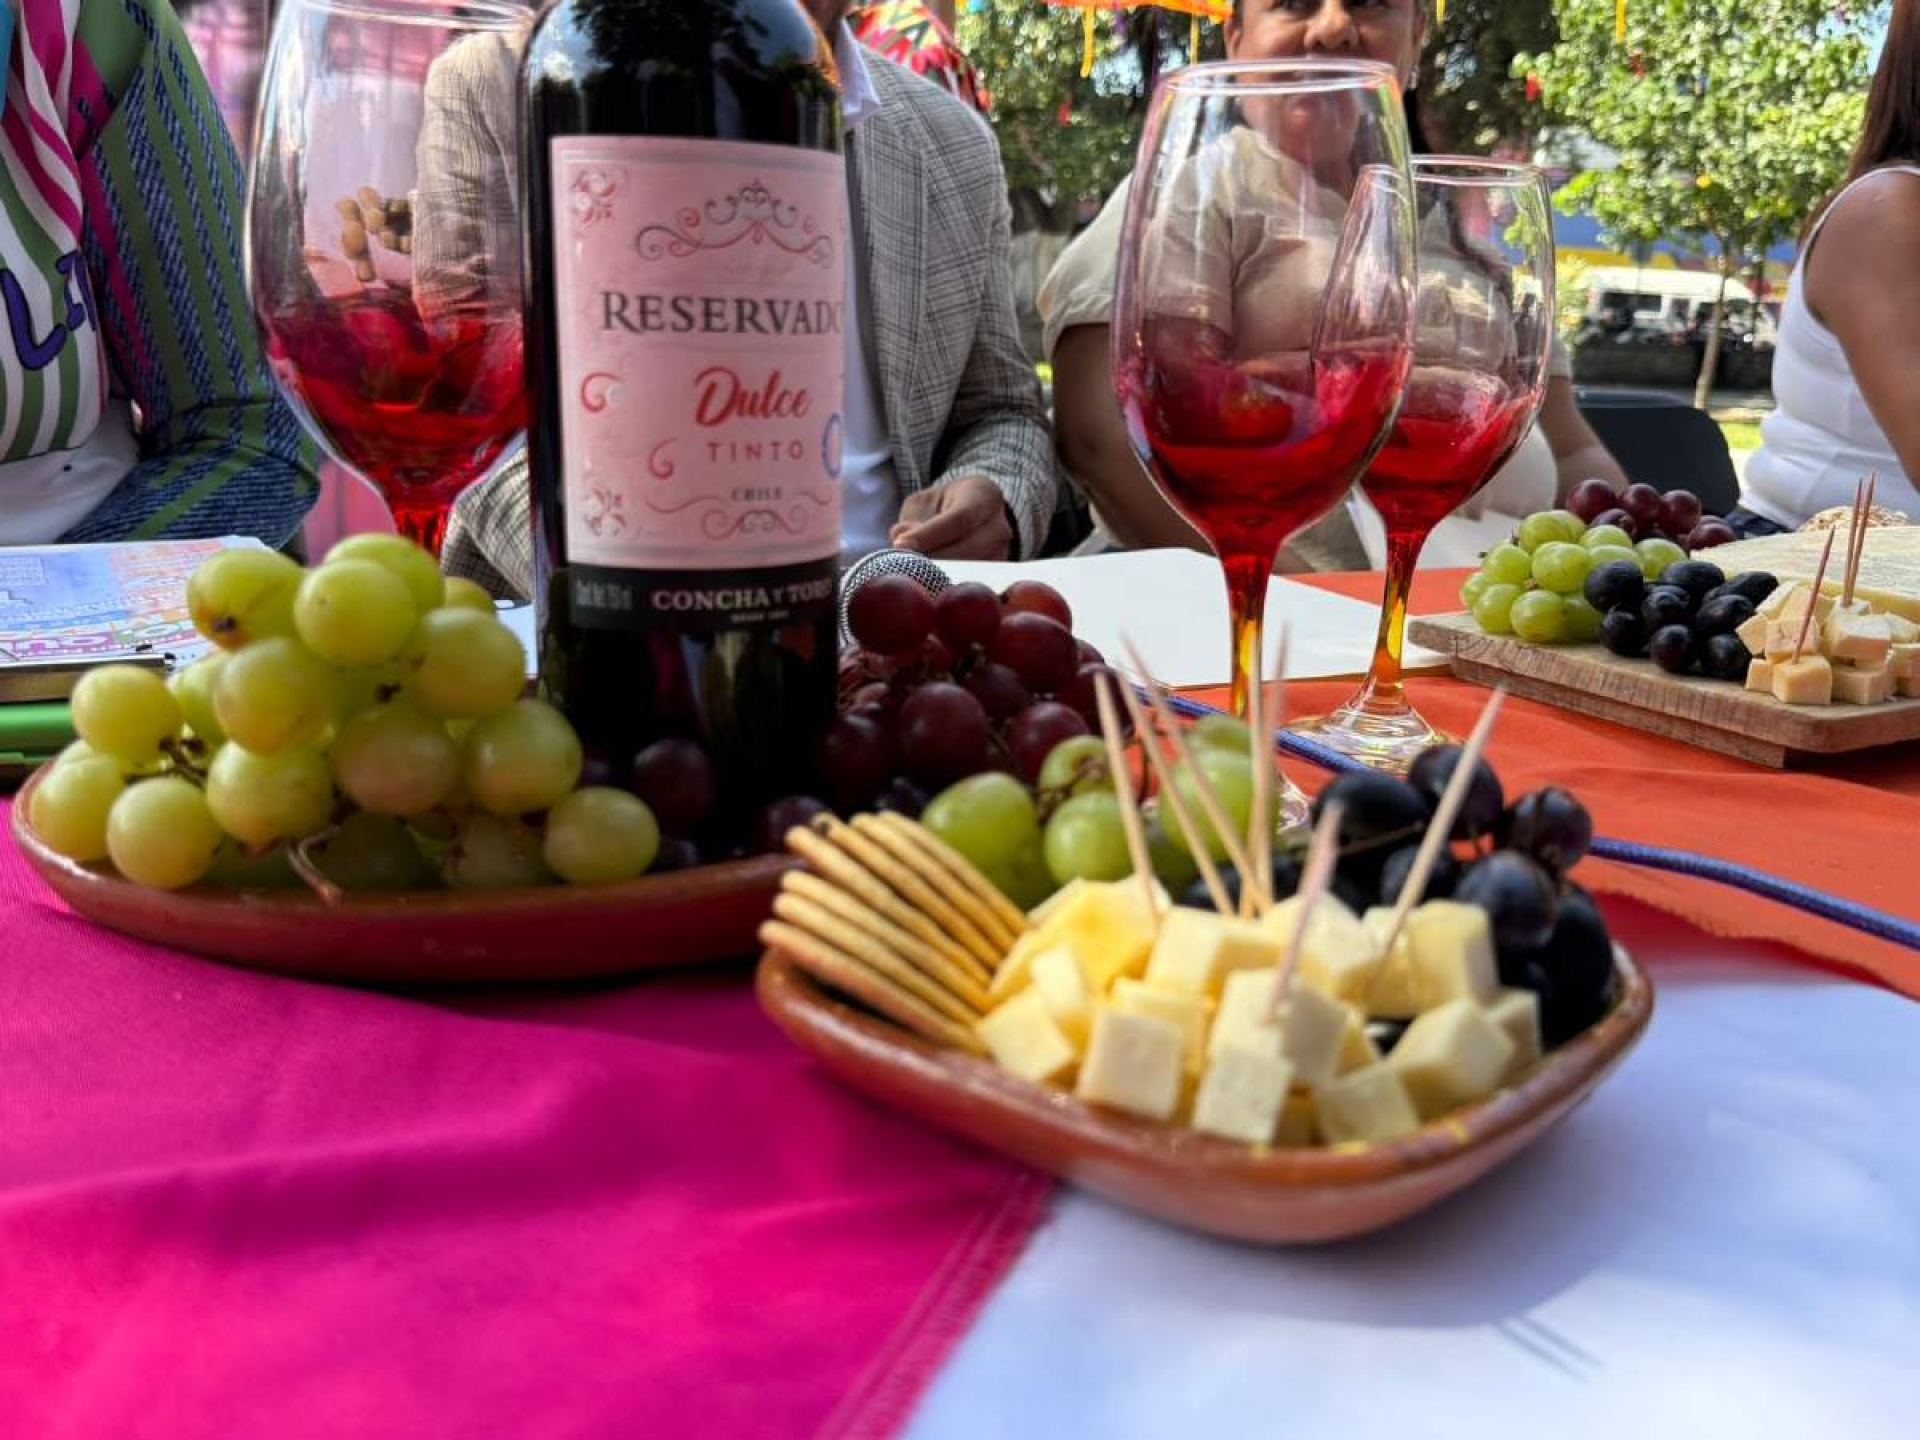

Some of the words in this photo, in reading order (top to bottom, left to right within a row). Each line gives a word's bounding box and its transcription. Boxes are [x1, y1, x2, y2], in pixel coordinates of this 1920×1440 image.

[694, 365, 809, 427] Dulce
[706, 440, 804, 461] TINTO
[652, 588, 770, 612] CONCHA
